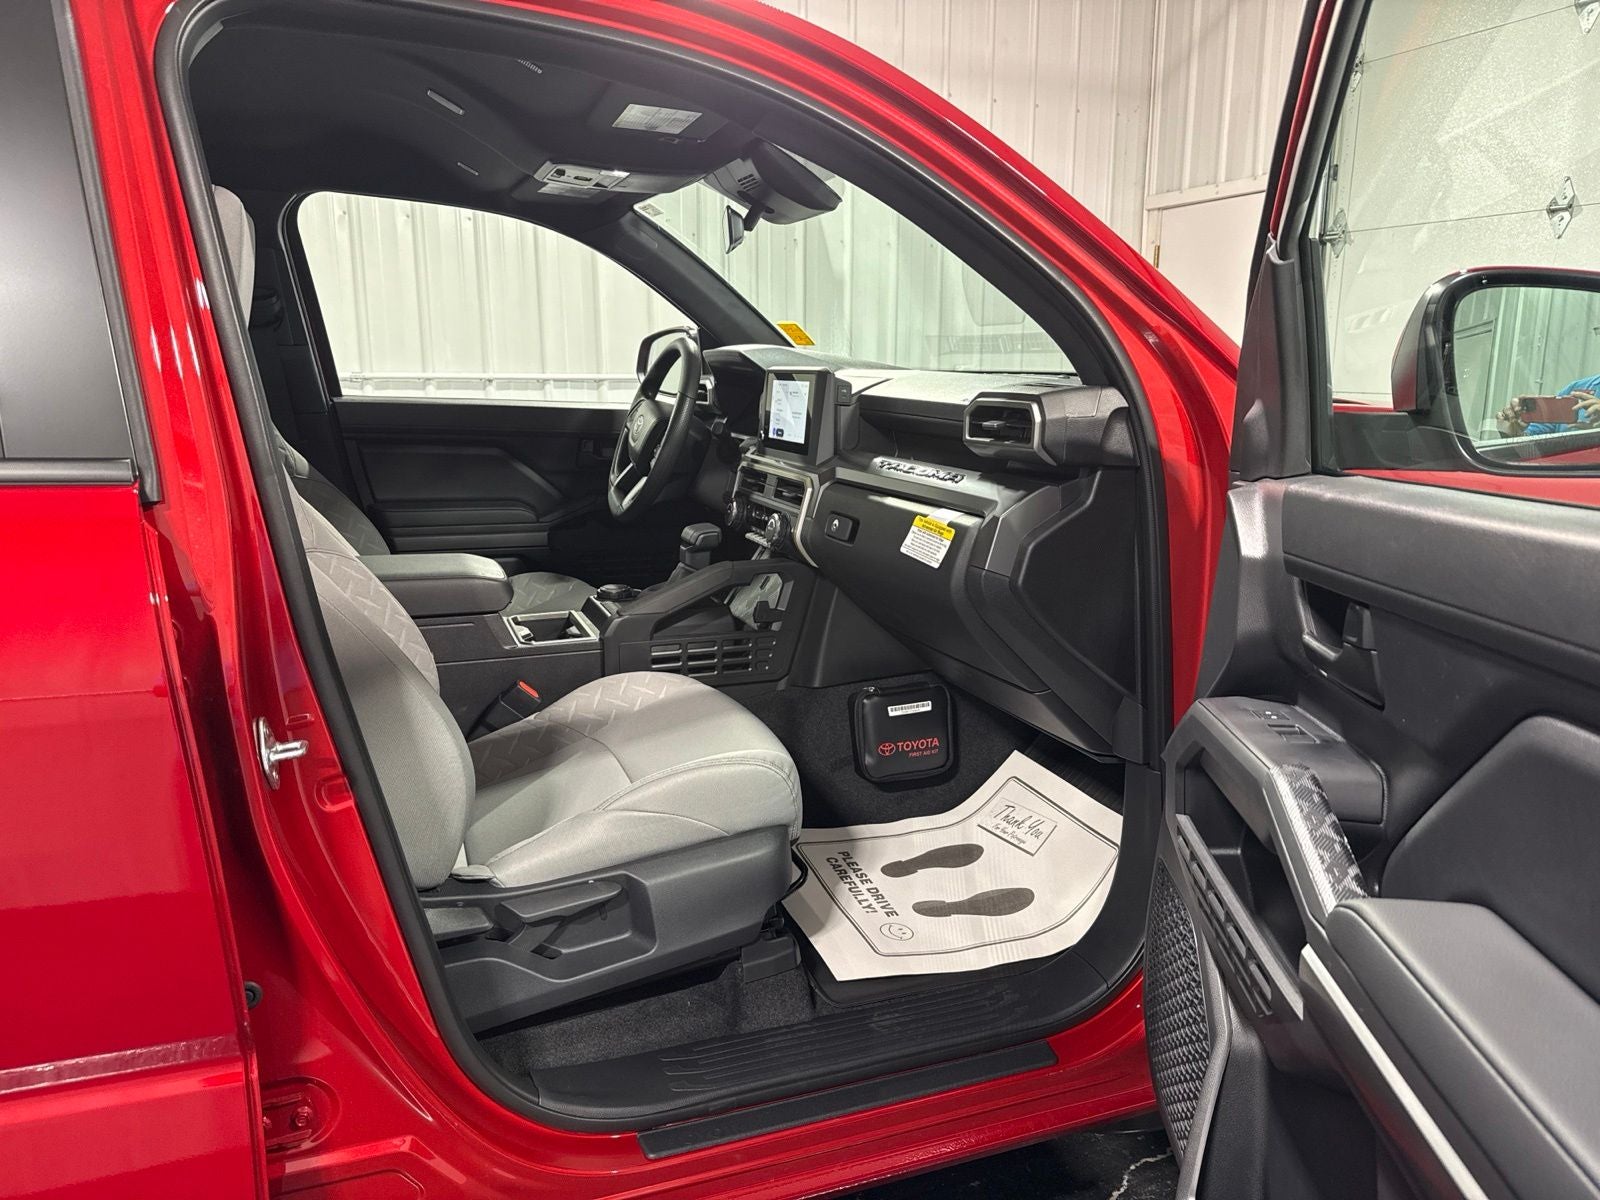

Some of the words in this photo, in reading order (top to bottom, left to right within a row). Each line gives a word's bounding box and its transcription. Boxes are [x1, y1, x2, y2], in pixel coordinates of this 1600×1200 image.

[879, 460, 967, 484] TACOMA
[897, 737, 940, 752] TOYOTA
[993, 804, 1033, 828] Thank
[1024, 819, 1045, 839] You
[826, 857, 879, 914] CAREFULLY!
[838, 851, 874, 886] PLEASE
[866, 886, 899, 918] DRIVE
